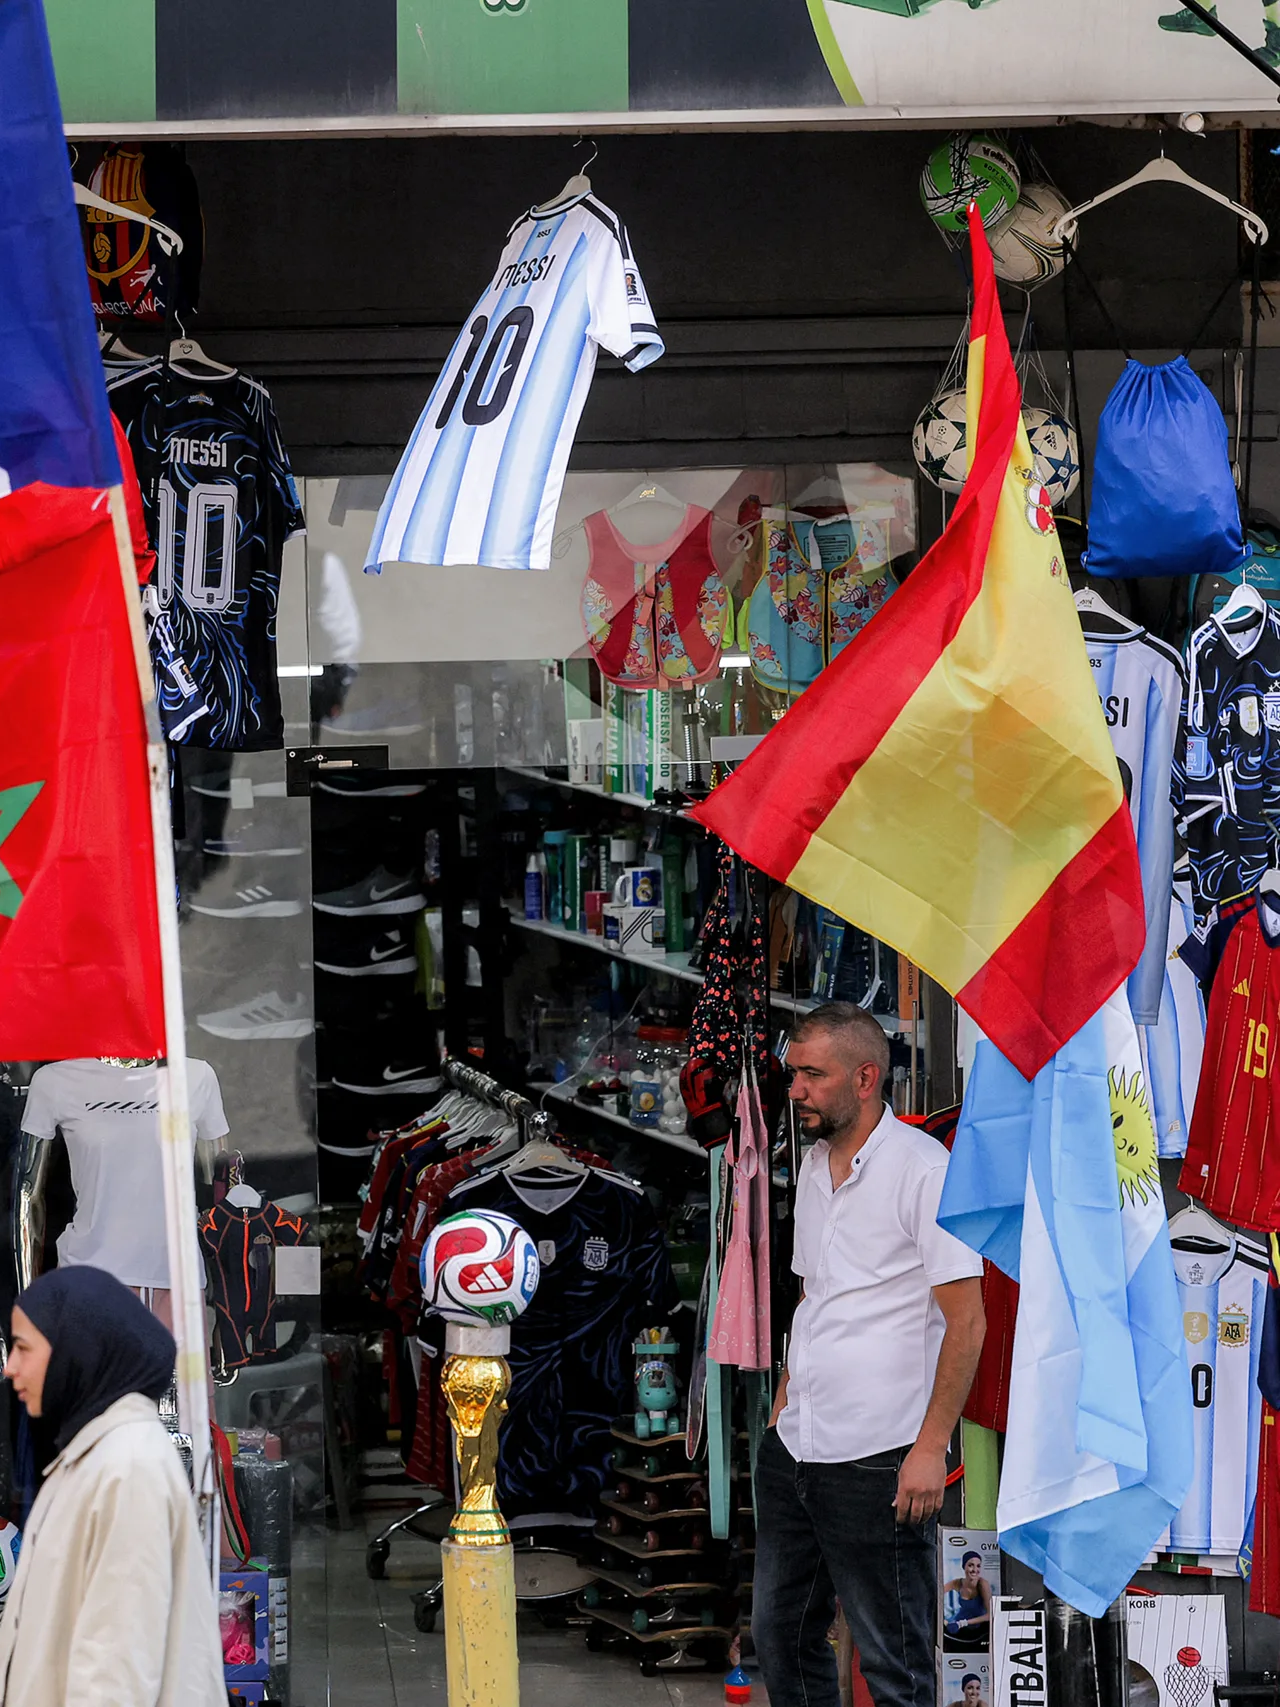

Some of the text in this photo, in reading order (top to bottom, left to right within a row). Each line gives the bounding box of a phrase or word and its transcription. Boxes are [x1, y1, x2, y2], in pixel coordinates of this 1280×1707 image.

[494, 254, 556, 291] MESSI
[435, 306, 534, 429] 10
[169, 437, 227, 467] MESSI
[151, 477, 238, 613] 10
[1089, 658, 1102, 667] 93
[660, 691, 670, 744] ROSENSA
[1244, 1018, 1269, 1078] 19
[1224, 1322, 1241, 1340] AFA
[1191, 1364, 1213, 1408] 0
[980, 1543, 999, 1551] GYM
[1128, 1600, 1156, 1609] KORB
[980, 1665, 990, 1673] GY
